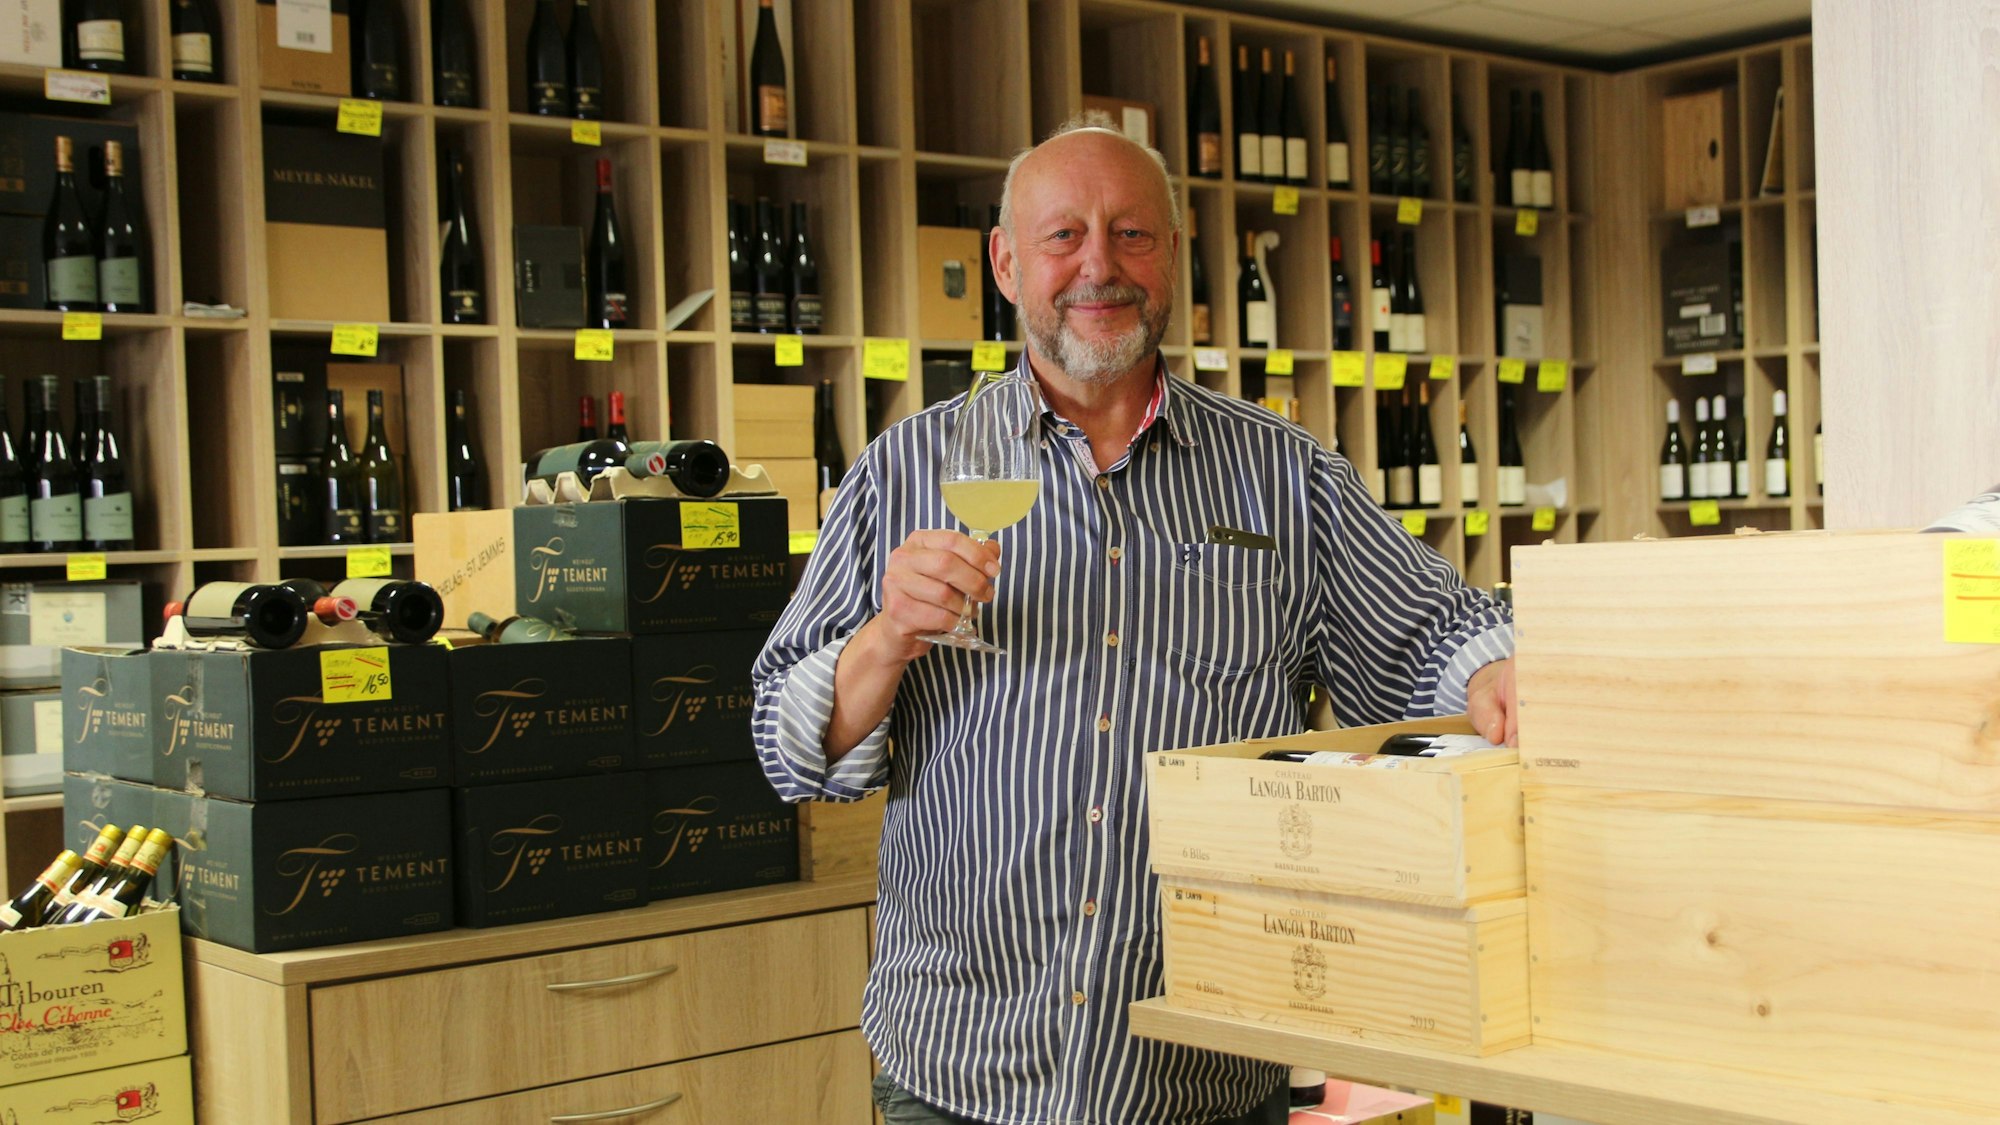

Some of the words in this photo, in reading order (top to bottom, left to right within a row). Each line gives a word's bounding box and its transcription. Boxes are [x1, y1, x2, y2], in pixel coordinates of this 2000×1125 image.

[272, 168, 377, 191] MEYER-NÄKEL
[562, 567, 608, 582] TEMENT
[709, 561, 786, 580] TEMENT
[373, 704, 421, 714] WEINGUT
[715, 694, 752, 711] TEM
[105, 710, 147, 728] TEMENT
[352, 713, 446, 734] TEMENT
[544, 705, 629, 726] TEMENT
[192, 720, 235, 740] TEMENT
[1275, 769, 1312, 780] CHÂTEAU
[717, 817, 793, 840] TEMENT
[560, 837, 644, 861] TEMENT
[1182, 847, 1188, 858] 6
[198, 867, 240, 891] TEMENT
[355, 858, 448, 884] TEMENT
[1394, 870, 1420, 885] 2019
[1289, 908, 1327, 919] CHÂTEAU
[0, 981, 104, 1007] Tibouren
[1196, 981, 1201, 991] 6
[43, 1005, 112, 1026] Cibonne
[1410, 1015, 1435, 1030] 2019
[41, 1048, 54, 1056] de
[55, 1042, 99, 1054] Provence
